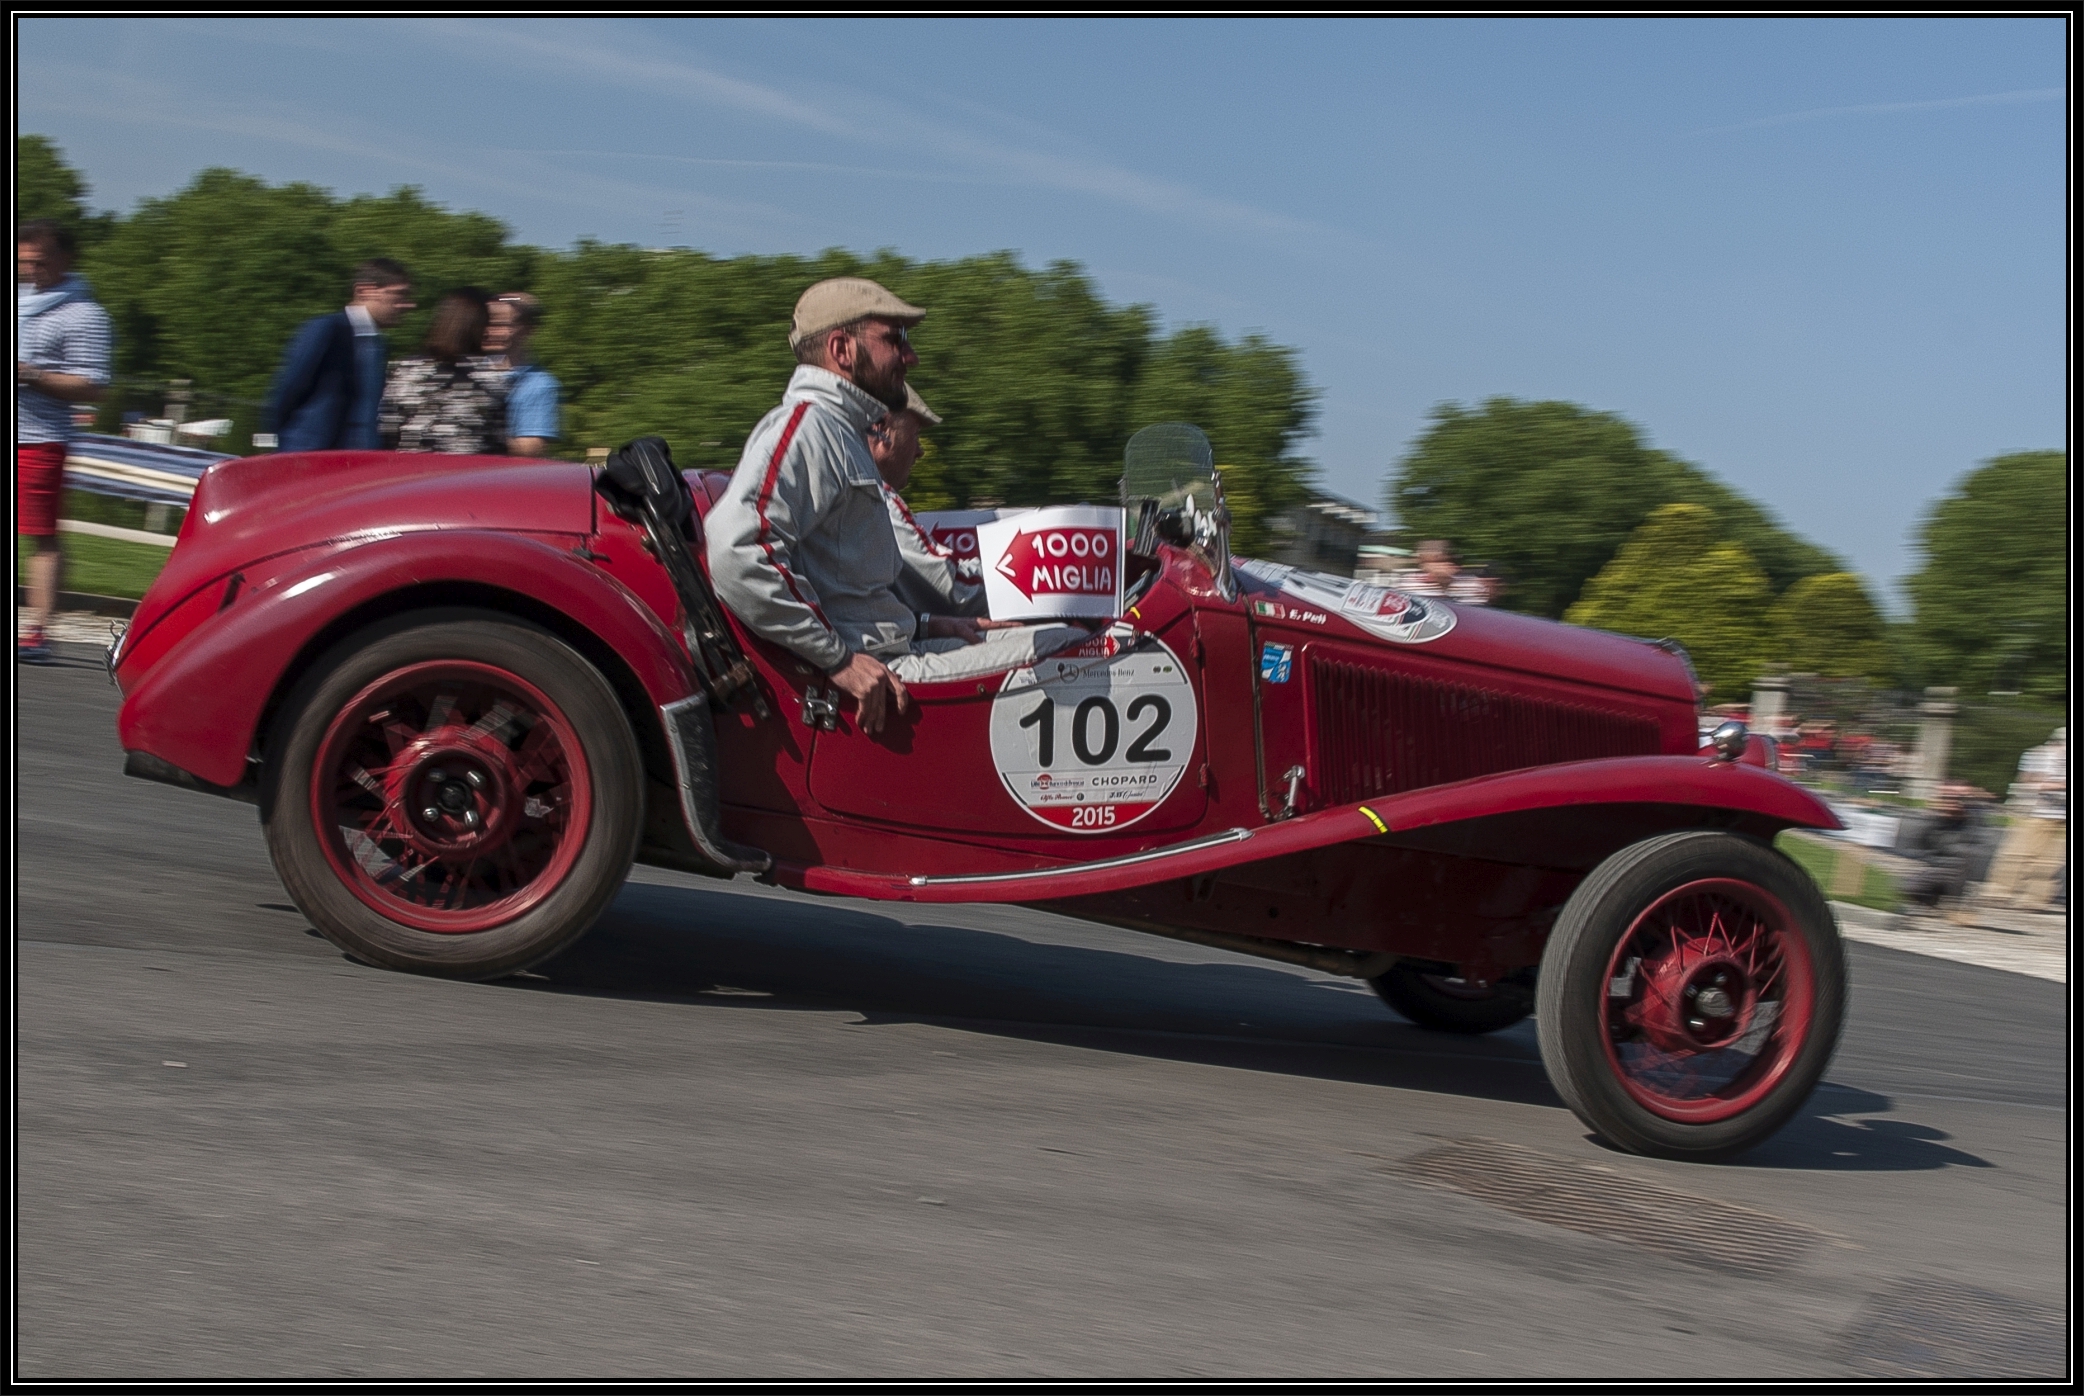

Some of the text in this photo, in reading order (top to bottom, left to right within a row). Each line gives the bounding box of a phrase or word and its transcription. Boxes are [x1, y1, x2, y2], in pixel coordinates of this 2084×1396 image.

[1031, 533, 1108, 559] 1000
[1032, 565, 1112, 591] MIGLIA
[1019, 694, 1172, 768] 102
[1092, 775, 1157, 786] CHOPARD
[1072, 806, 1116, 827] 2015
